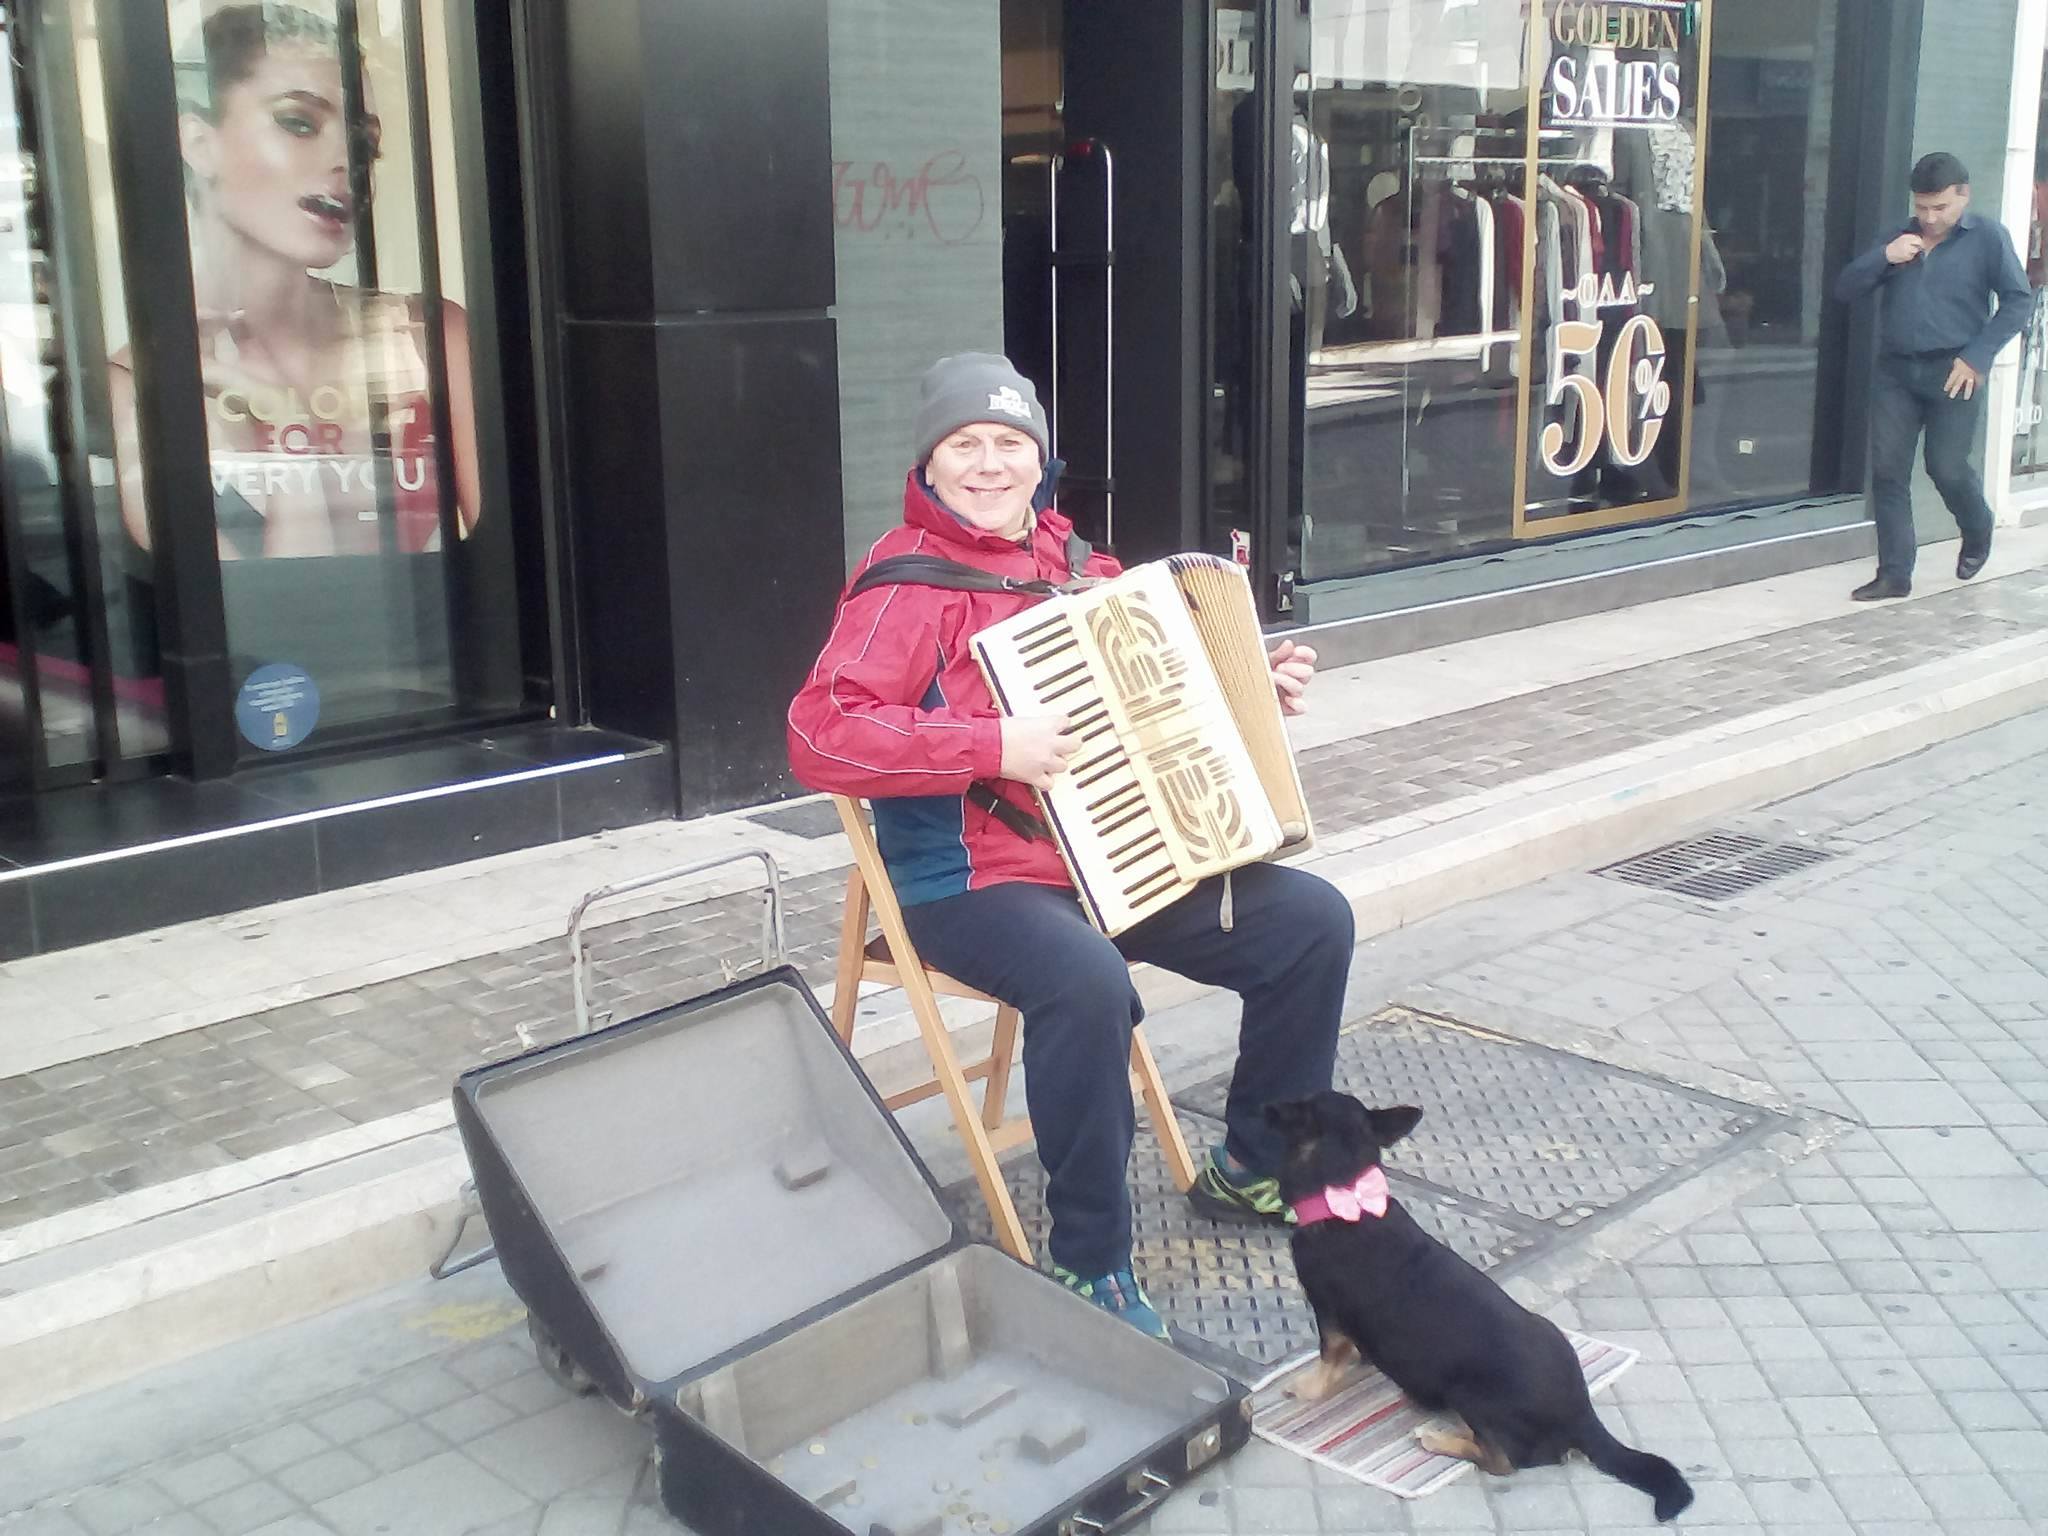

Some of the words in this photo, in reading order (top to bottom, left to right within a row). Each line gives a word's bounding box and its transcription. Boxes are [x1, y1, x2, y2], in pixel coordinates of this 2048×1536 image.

[1554, 0, 1680, 51] GOLDEN
[1552, 56, 1681, 120] SALES
[1541, 314, 1671, 476] 50%
[256, 423, 344, 454] FOR
[211, 458, 319, 496] VERY
